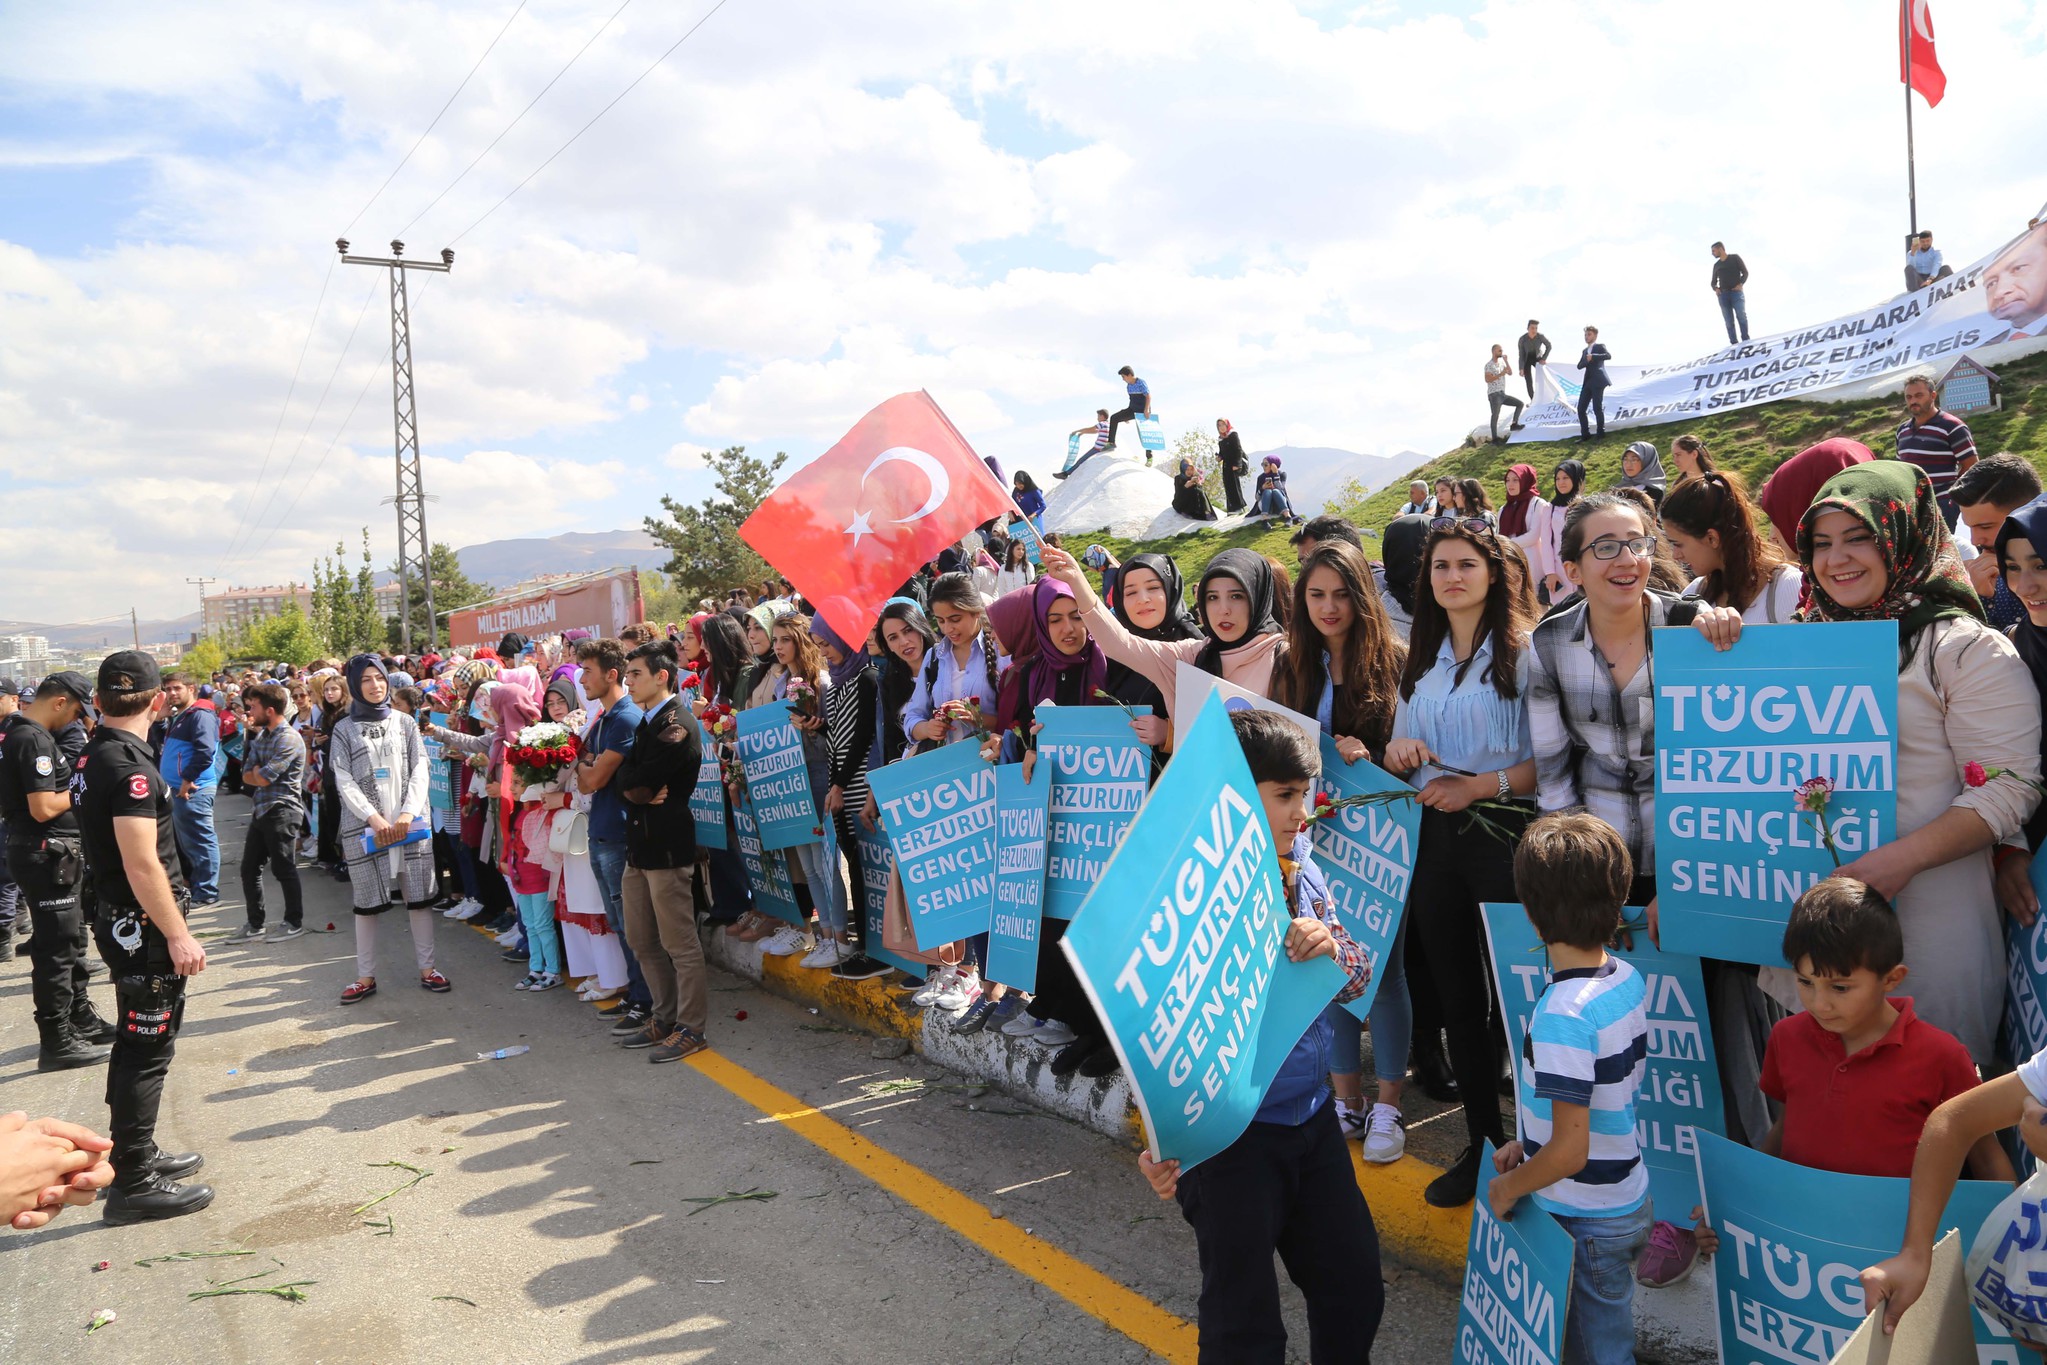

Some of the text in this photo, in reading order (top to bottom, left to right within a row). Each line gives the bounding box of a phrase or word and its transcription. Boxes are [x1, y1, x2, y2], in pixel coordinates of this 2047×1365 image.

[1783, 300, 1921, 350] YIKANLARA
[1693, 351, 1822, 391] TUTACAĞIZ
[1707, 369, 1842, 409] SEVECEĞİZ
[1852, 345, 1911, 378] SENİ
[1917, 328, 1980, 360] REİS
[522, 599, 557, 628] ADAMI
[1661, 684, 1889, 736] TÜGVA
[739, 724, 800, 757] TÜGVA
[747, 750, 804, 778] ERZURUM
[1667, 749, 1885, 790] ERZURUM
[752, 771, 807, 801] GENÇLİĞİ
[1052, 784, 1142, 811] RZURUM
[758, 799, 812, 824] SENİNLE!
[1000, 808, 1044, 838] TÜGVA
[1668, 805, 1879, 856] GENÇLİĞİ
[859, 840, 893, 869] TÜG
[908, 837, 996, 884] GENÇLİ
[1000, 847, 1043, 870] ERZURUM
[1049, 855, 1107, 883] ENİN
[1314, 825, 1403, 901] ZURUM
[917, 873, 995, 915] SENİN
[998, 879, 1039, 909] GENÇLİĞİ
[1114, 784, 1251, 1008] TÜGVA
[1671, 859, 1819, 904] SENİN
[995, 914, 1035, 941] SENİNLE!
[1146, 825, 1265, 1055] ERZURUM
[1167, 872, 1274, 1088] GENÇLİĞİ
[1183, 918, 1282, 1126] SENİNLE!
[1475, 1198, 1556, 1359] TÜGVA
[1723, 1219, 1866, 1318] TÜG
